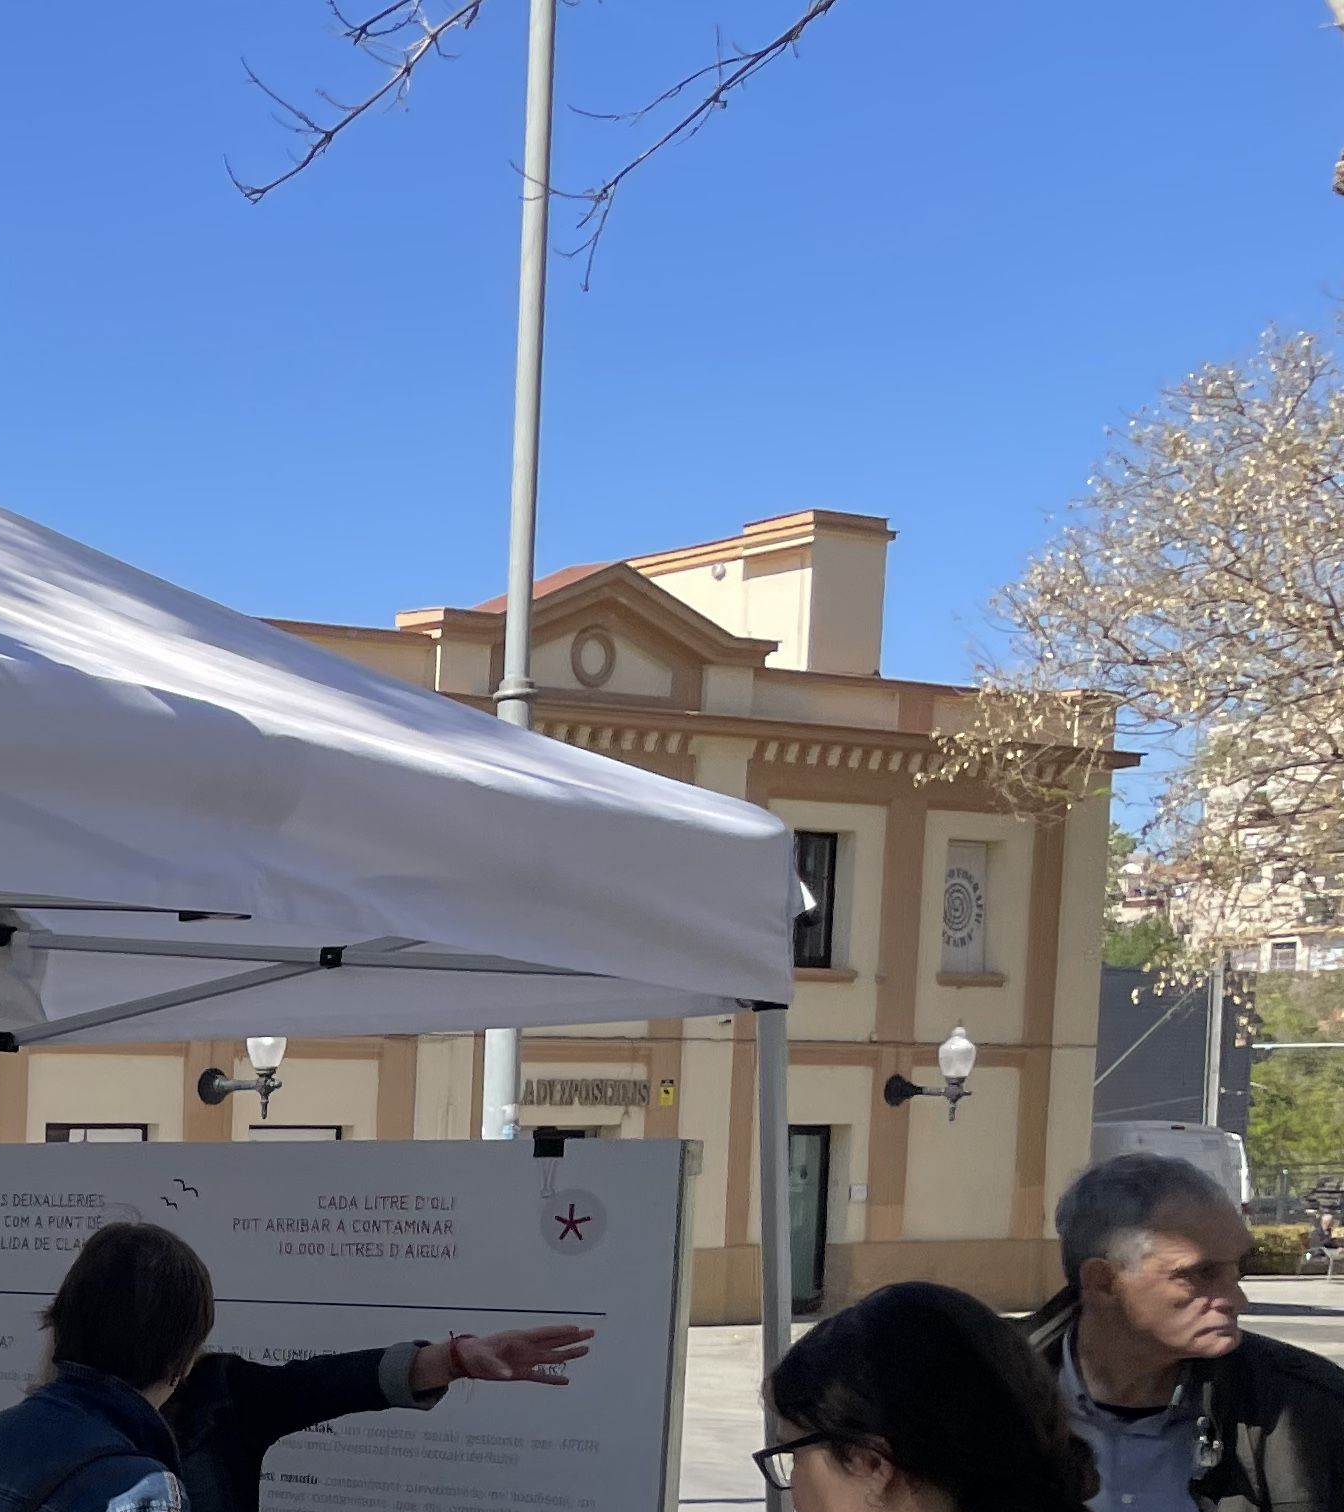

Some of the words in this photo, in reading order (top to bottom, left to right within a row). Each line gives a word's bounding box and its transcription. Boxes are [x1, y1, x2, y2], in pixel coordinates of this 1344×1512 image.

[12, 1193, 105, 1208] DEIXALLERIES
[318, 1196, 358, 1211] CADA
[364, 1195, 409, 1211] LITRE
[4, 1215, 30, 1229] COM
[34, 1215, 43, 1229] A
[47, 1215, 83, 1230] PUNT
[87, 1215, 105, 1231] DE
[232, 1218, 259, 1232] POT
[266, 1218, 330, 1233] ARRIBAR
[336, 1219, 345, 1233] A
[352, 1219, 453, 1235] CONTAMINAR
[34, 1236, 50, 1250] DE
[330, 1242, 384, 1258] LITRES
